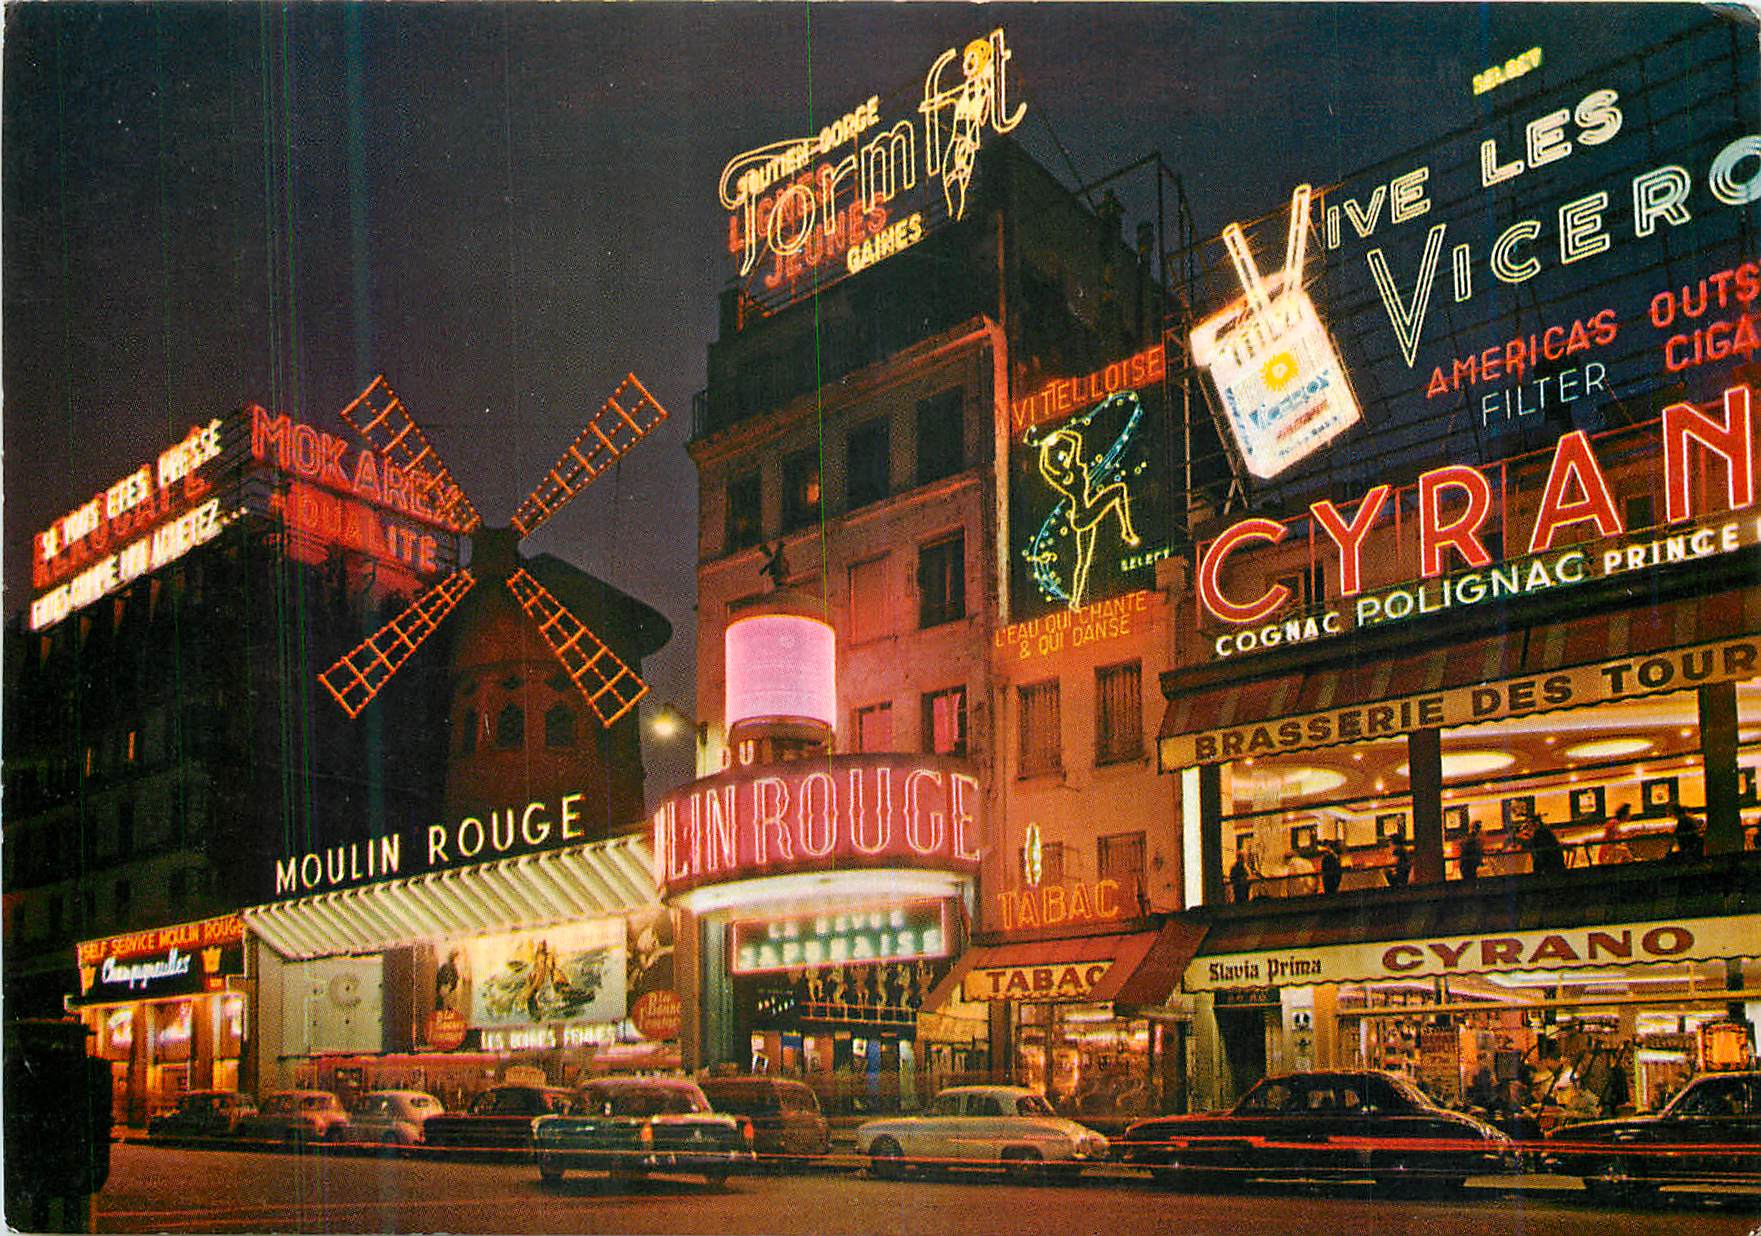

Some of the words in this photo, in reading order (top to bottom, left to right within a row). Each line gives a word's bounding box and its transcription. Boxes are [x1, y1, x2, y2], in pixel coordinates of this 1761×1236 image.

[1481, 88, 1624, 188] LES
[847, 212, 923, 275] GAINES
[1426, 308, 1618, 399] AMERICA'S
[1481, 362, 1606, 427] FILTER
[1199, 381, 1755, 625] CYRAN
[995, 618, 1040, 649] L'EAU
[1045, 610, 1072, 635] QUI
[1078, 590, 1148, 624] CHANTE
[1214, 612, 1342, 658] COGNAC
[1356, 550, 1587, 628] POLIGNAC
[1603, 522, 1741, 576] PRINCE
[1019, 639, 1032, 660] &
[1038, 630, 1065, 656] QUI
[1072, 613, 1131, 648] DANSE
[1193, 696, 1446, 760] BRASSERIE
[1471, 674, 1574, 716] DES
[1605, 643, 1758, 695] TOUR
[275, 833, 401, 895] MOULIN
[428, 793, 586, 865] ROUGE
[753, 767, 981, 864] ROUGE
[998, 878, 1121, 930] TABAC
[985, 965, 1106, 994] TABAC
[1208, 960, 1260, 982] Slavia
[1266, 956, 1322, 982] Prima
[1381, 925, 1696, 972] CYRANO
